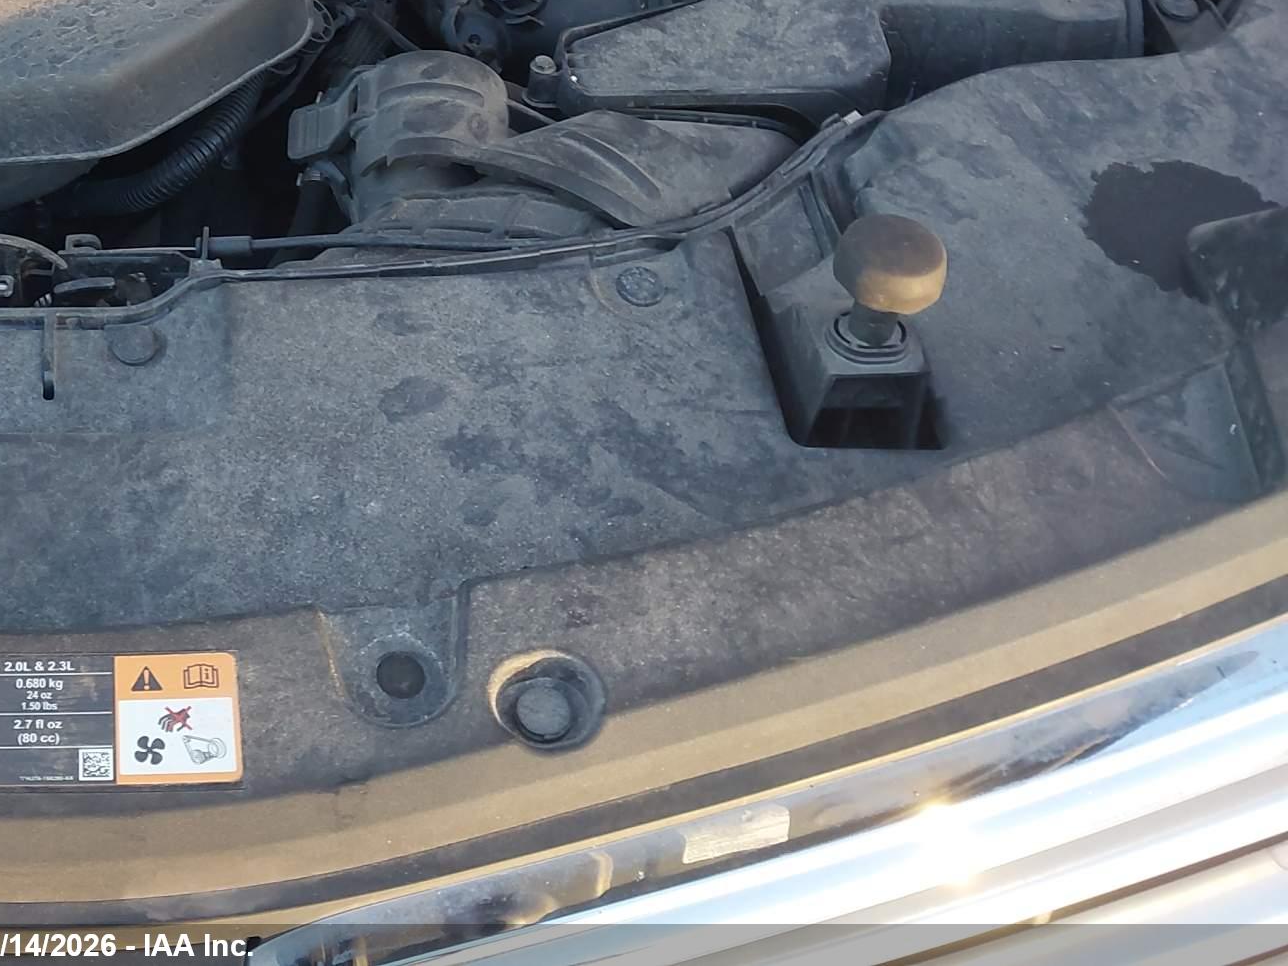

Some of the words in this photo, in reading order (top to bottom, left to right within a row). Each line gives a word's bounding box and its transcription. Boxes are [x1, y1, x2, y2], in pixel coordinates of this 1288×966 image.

[4, 661, 31, 672] 2.0L
[34, 661, 44, 671] &
[47, 660, 75, 671] 2.3L
[15, 678, 46, 688] 0.680
[48, 678, 63, 690] kg
[26, 691, 39, 699] 24
[21, 702, 41, 710] 1.50
[42, 701, 58, 710] lbs
[13, 720, 33, 729] 2.7
[35, 719, 44, 729] fl
[47, 721, 63, 729] oz
[17, 733, 37, 745] (80
[40, 733, 60, 745] cc)
